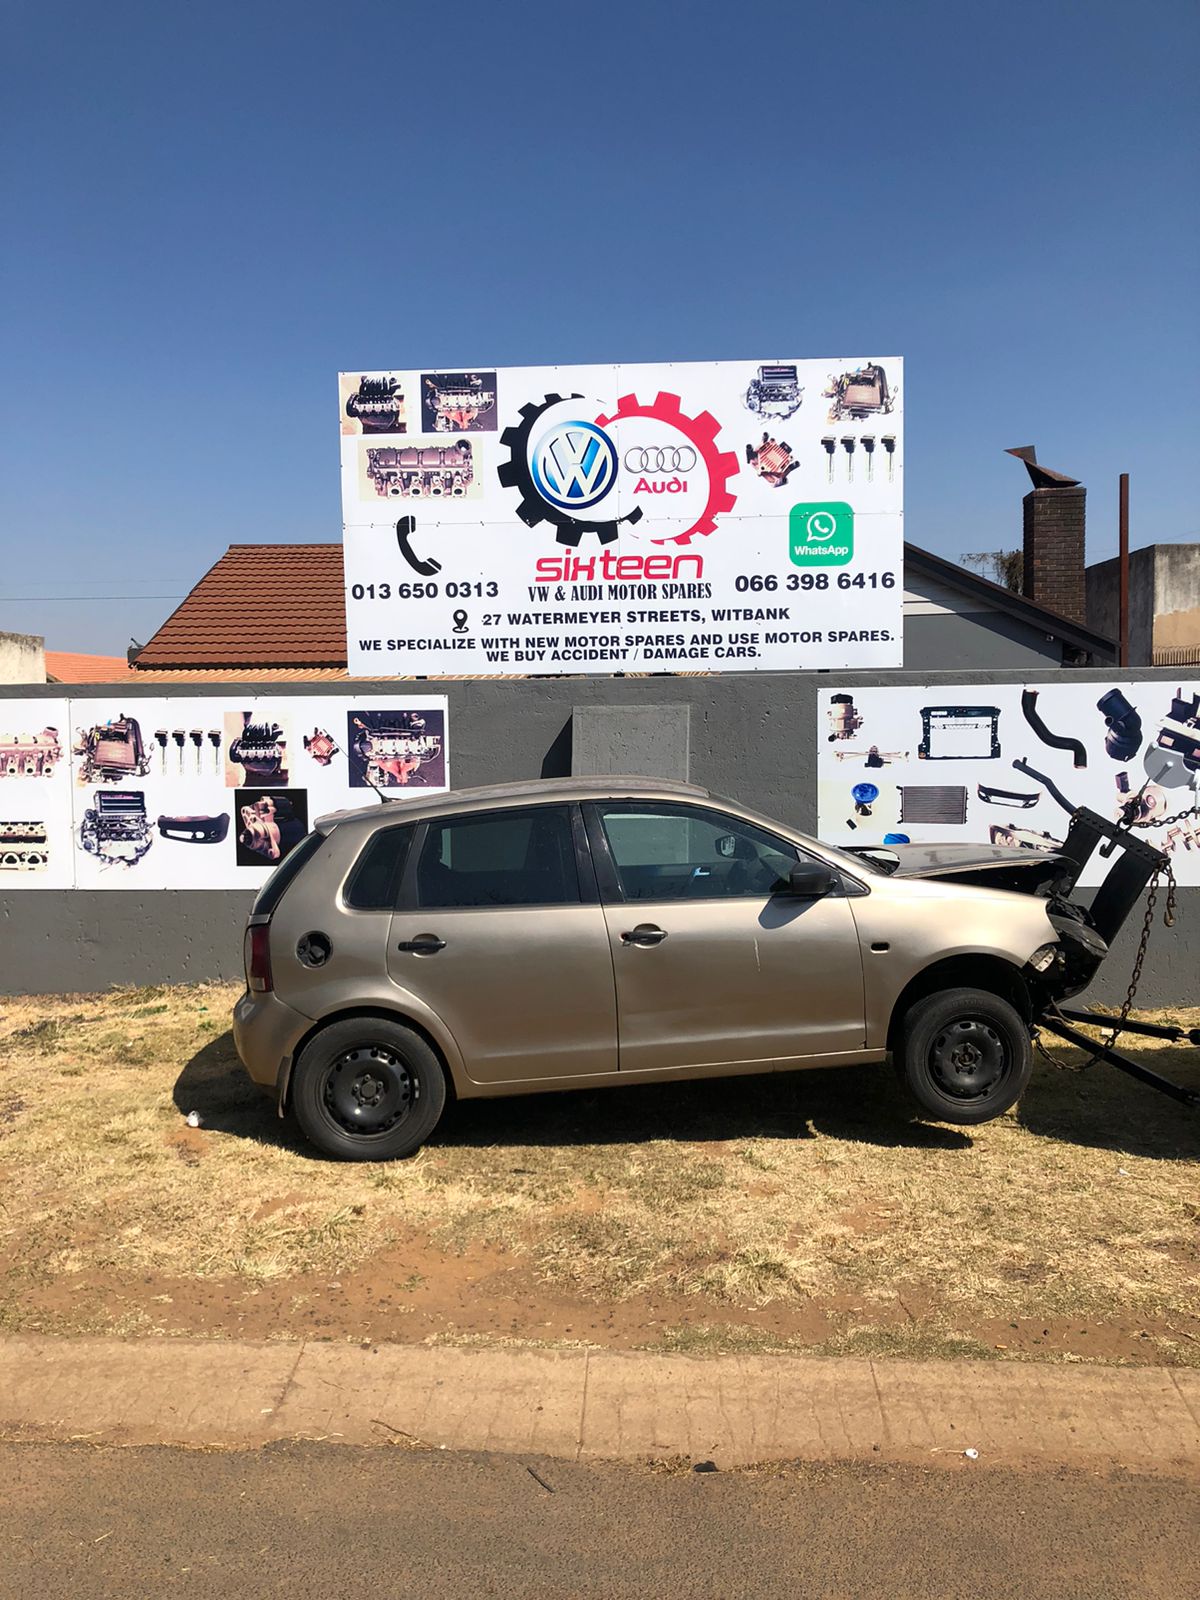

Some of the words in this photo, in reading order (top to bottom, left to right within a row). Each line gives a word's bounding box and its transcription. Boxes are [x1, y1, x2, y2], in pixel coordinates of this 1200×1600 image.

[633, 477, 687, 494] Audi
[794, 545, 849, 556] WhatsApp
[535, 549, 703, 582] sixteen
[352, 584, 391, 599] 013
[399, 583, 438, 599] 650
[446, 581, 498, 598] 0313
[735, 575, 778, 592] 066
[786, 574, 829, 590] 398
[837, 571, 895, 589] 6416
[528, 586, 549, 602] VW
[555, 586, 565, 601] &
[571, 585, 603, 601] AUDI
[608, 584, 657, 600] MOTOR
[662, 583, 711, 599] SPARES
[483, 614, 501, 625] 27
[507, 612, 621, 625] WATERMEYER
[627, 610, 705, 624] STREETS,
[712, 608, 790, 621] WITBANK
[359, 640, 381, 650] WE
[387, 639, 476, 650] SPECIALIZE
[481, 638, 519, 649] WITH
[526, 637, 559, 648] NEW
[565, 636, 620, 647] MOTOR
[625, 635, 685, 646] SPARES
[690, 634, 722, 645] AND
[729, 633, 759, 644] USE
[765, 632, 822, 643] MOTOR
[828, 630, 894, 642] SPARES.
[486, 651, 509, 662] WE
[515, 650, 546, 661] BUY
[551, 649, 629, 660] ACCIDENT
[644, 648, 709, 659] DAMAGE
[715, 646, 761, 658] CARS.
